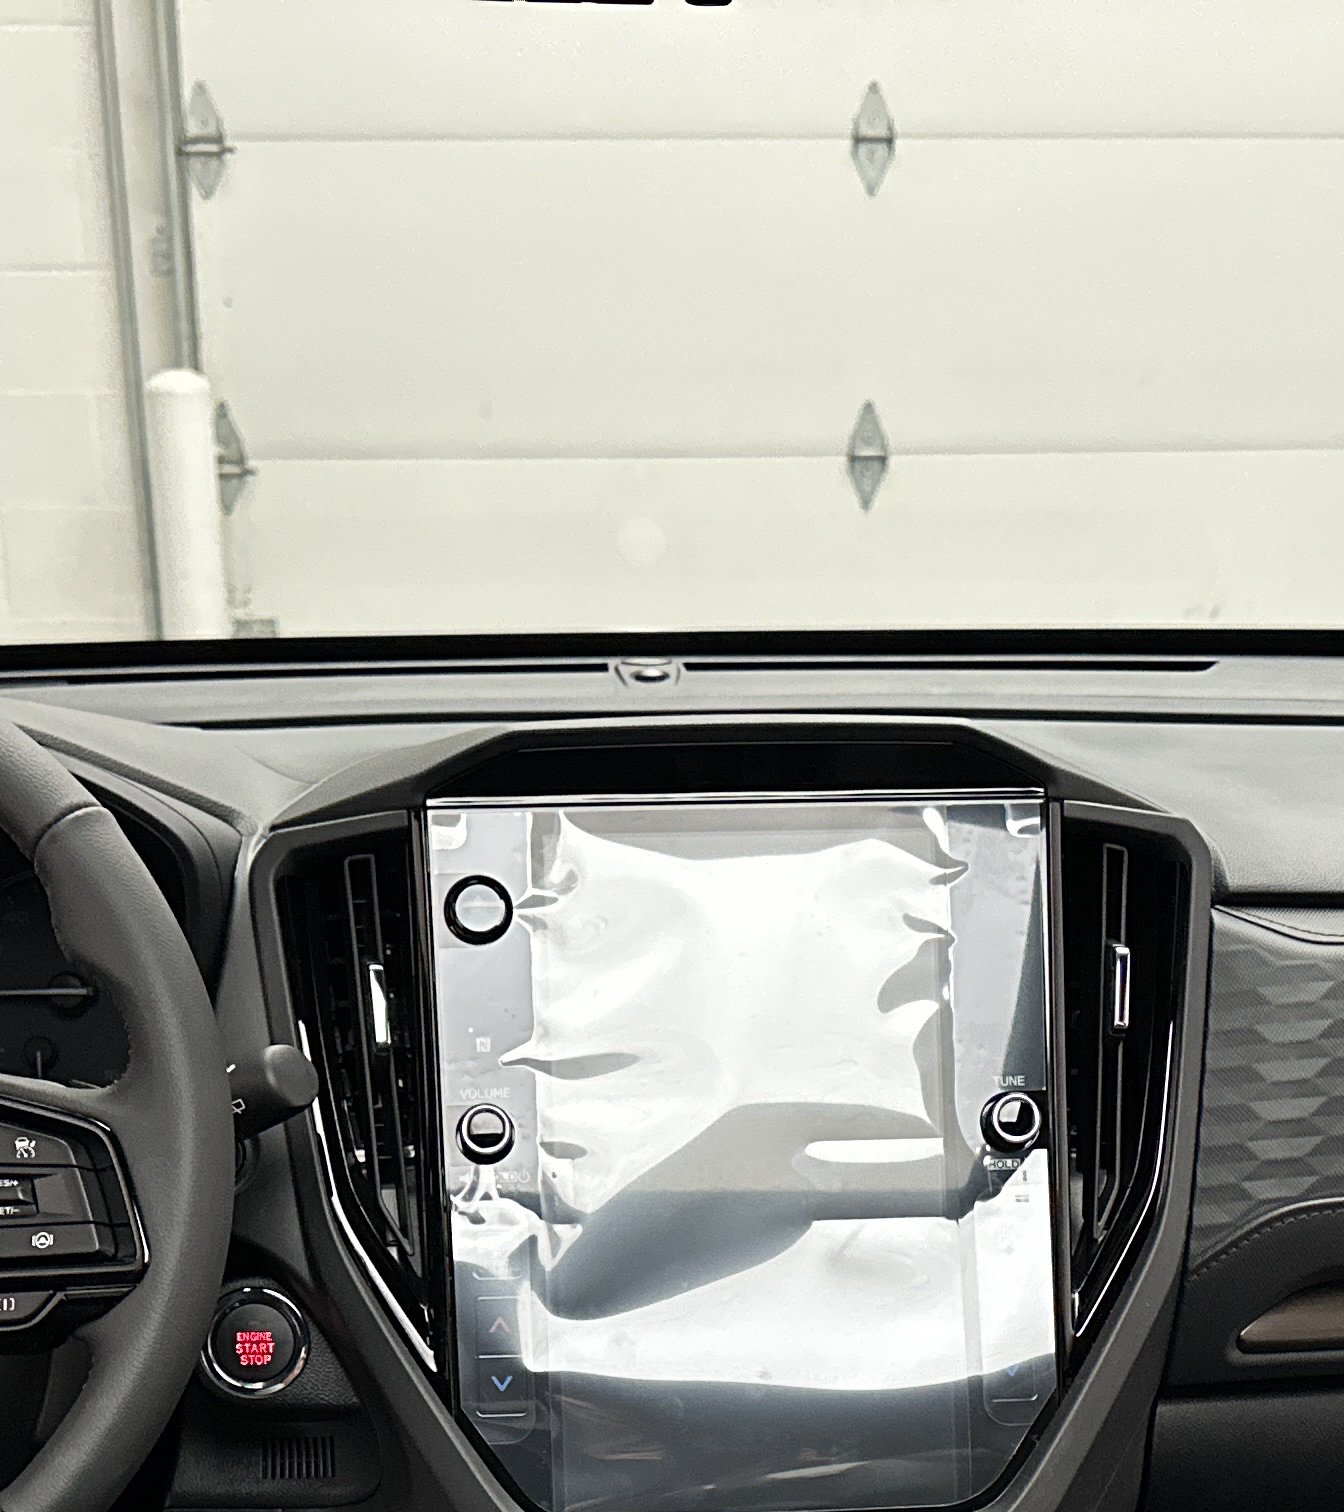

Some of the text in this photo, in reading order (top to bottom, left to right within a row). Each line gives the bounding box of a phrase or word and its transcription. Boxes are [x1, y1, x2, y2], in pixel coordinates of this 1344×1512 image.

[993, 1075, 1026, 1087] TUNE
[459, 1087, 511, 1100] VOLUME
[988, 1158, 1021, 1170] HOLD
[236, 1331, 273, 1342] ENGINE
[235, 1342, 275, 1354] START
[239, 1354, 272, 1366] STOP
